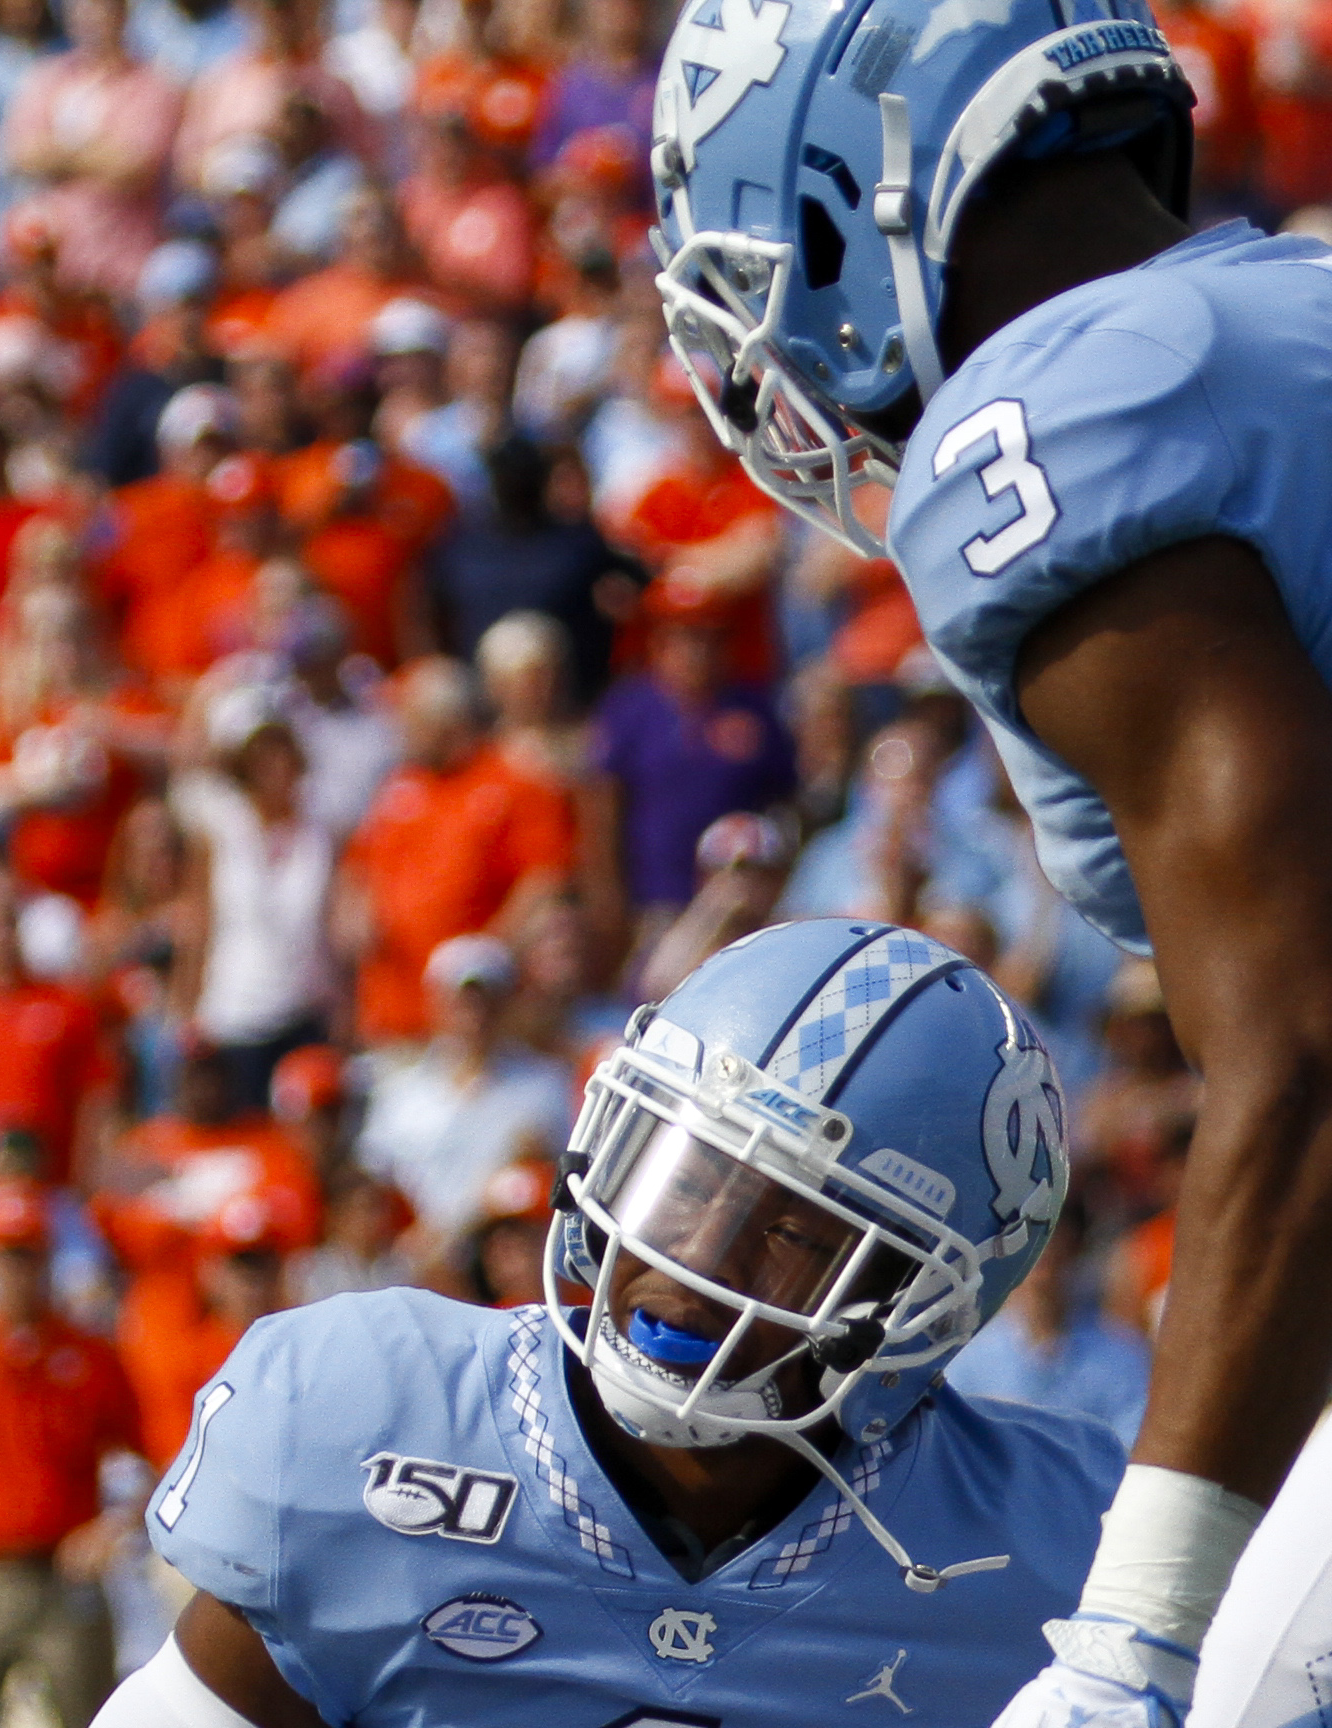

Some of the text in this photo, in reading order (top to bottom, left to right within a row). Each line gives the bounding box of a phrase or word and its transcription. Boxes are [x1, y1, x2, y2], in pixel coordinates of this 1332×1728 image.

[931, 396, 1062, 579] 3
[743, 1087, 822, 1129] ACC
[154, 1377, 236, 1534] 1
[359, 1451, 518, 1545] 150
[434, 1608, 528, 1640] ACC
